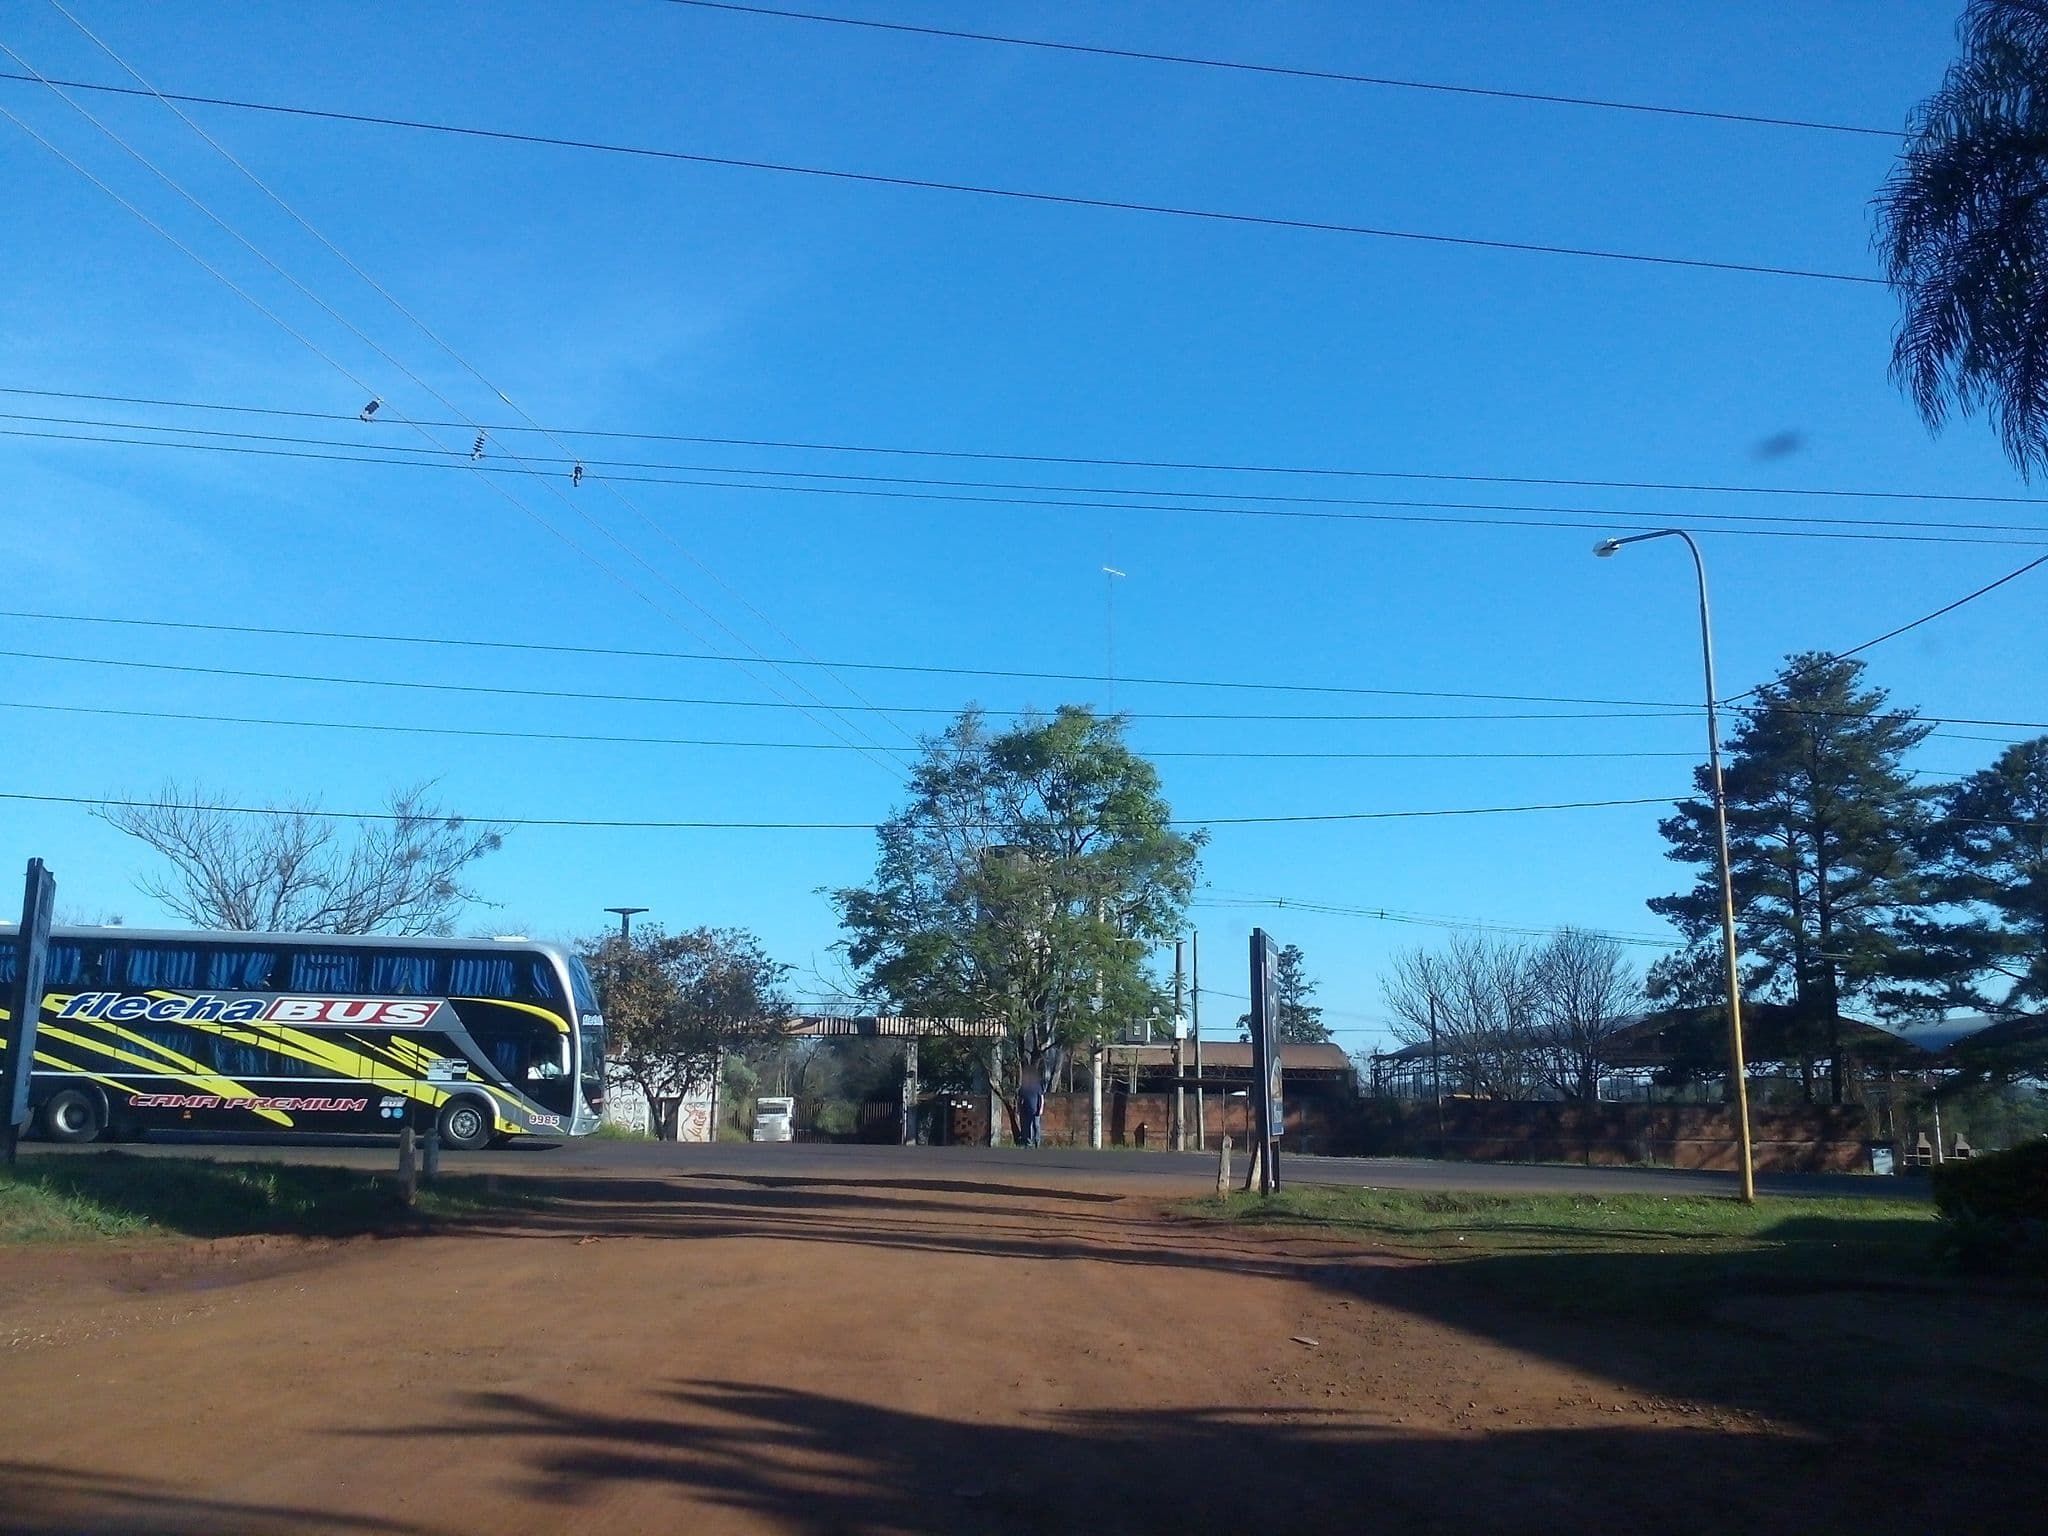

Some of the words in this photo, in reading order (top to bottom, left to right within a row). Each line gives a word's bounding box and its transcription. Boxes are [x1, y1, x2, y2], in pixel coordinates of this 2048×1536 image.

[57, 992, 267, 1022] flecha
[269, 1000, 430, 1024] BUS
[129, 1094, 221, 1109] CAMA
[223, 1097, 368, 1112] PREMIUM
[529, 1114, 560, 1126] 9985
